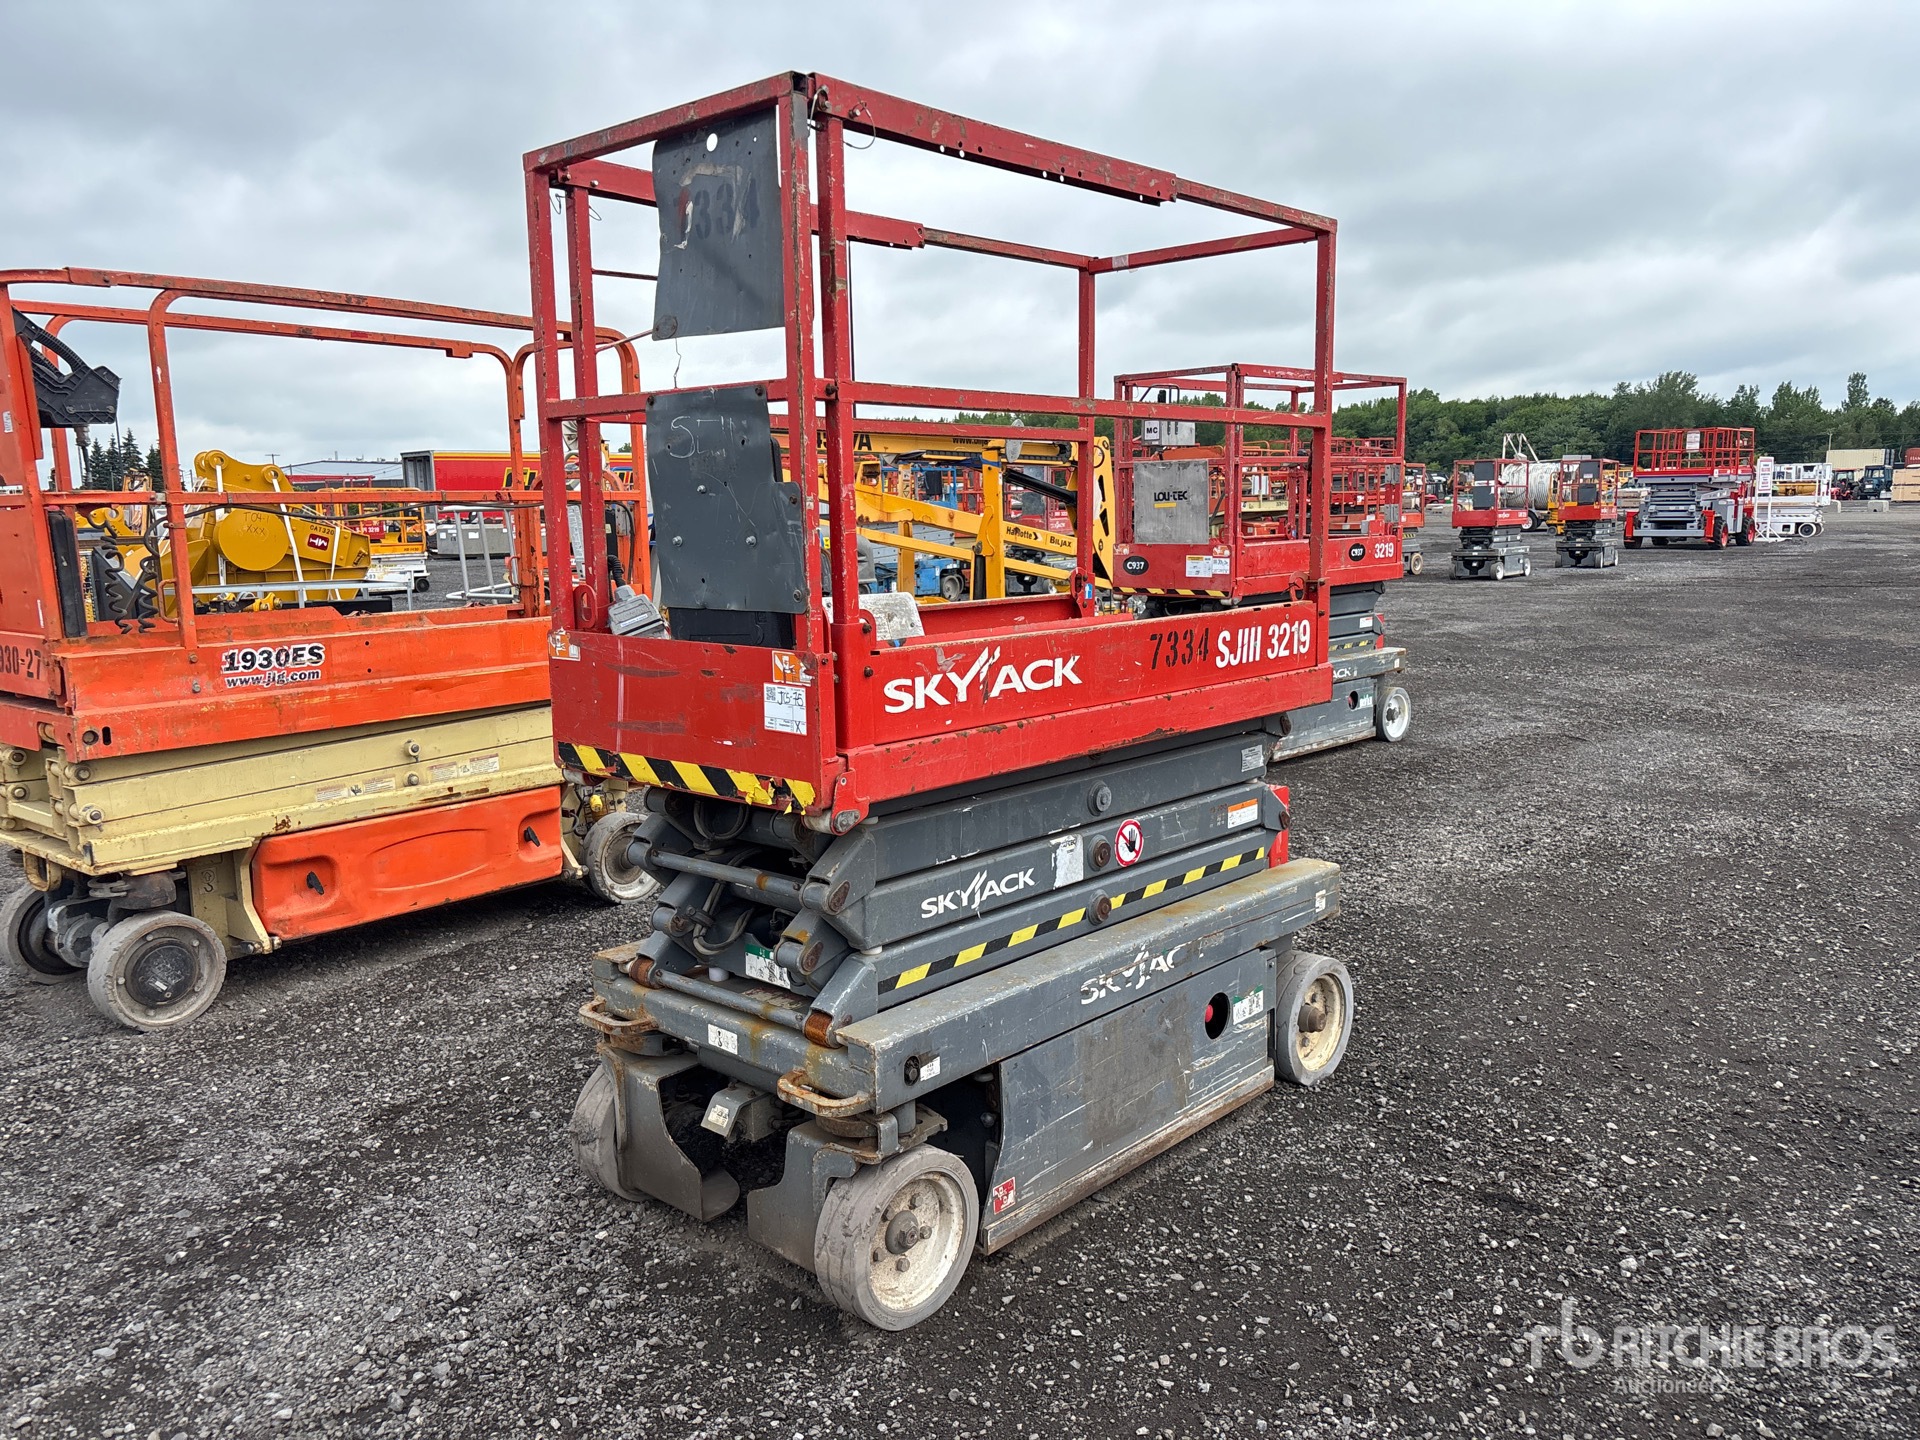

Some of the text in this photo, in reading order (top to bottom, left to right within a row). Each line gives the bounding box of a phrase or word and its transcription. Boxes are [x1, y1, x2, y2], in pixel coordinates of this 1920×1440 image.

[1146, 426, 1158, 434] MC
[309, 525, 335, 536] CAT320
[1374, 542, 1394, 559] 3219
[1126, 561, 1145, 570] C937
[1150, 627, 1209, 670] 7334
[1266, 619, 1311, 660] 3219
[223, 645, 324, 672] 1930ES
[920, 867, 1036, 919] SKYJACK
